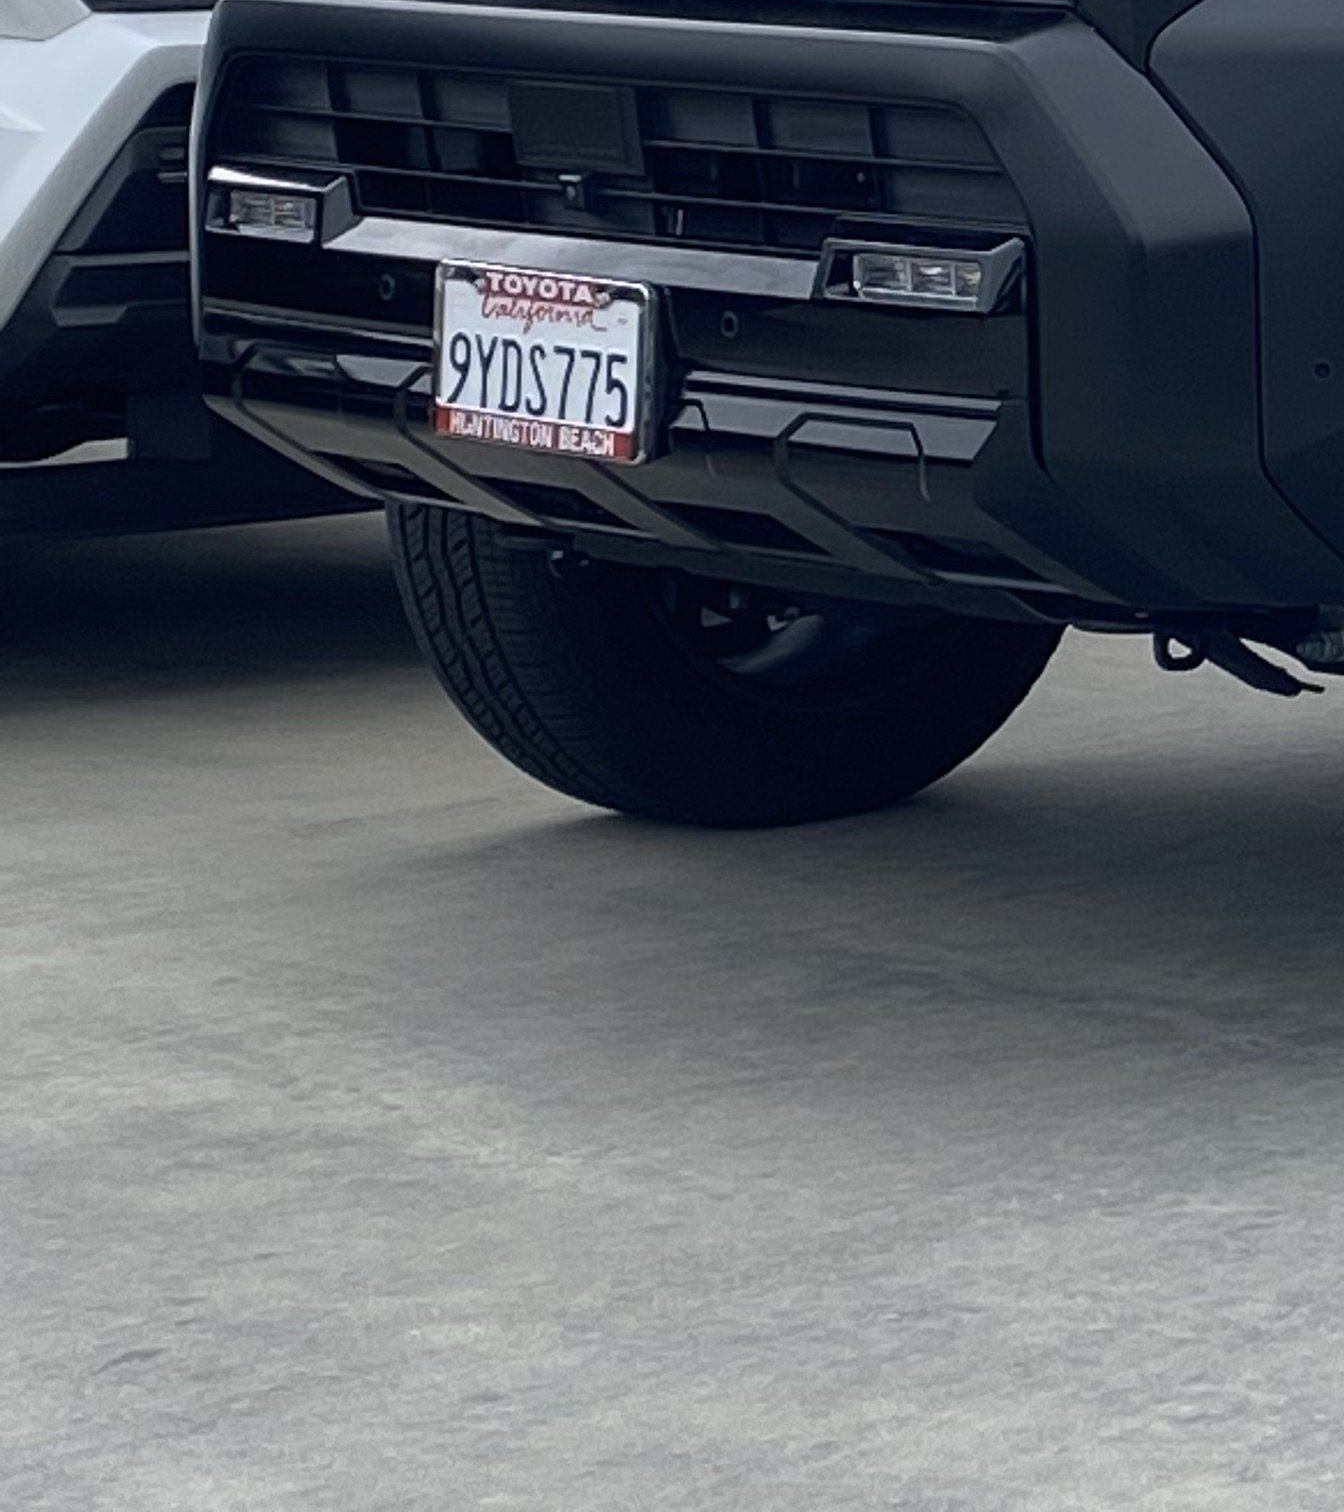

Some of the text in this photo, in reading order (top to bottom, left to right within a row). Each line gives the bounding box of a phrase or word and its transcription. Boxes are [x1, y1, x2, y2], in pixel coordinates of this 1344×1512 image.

[486, 271, 593, 303] TOYOTA
[447, 331, 629, 428] 9YDS775
[450, 411, 615, 457] HUNTINGTON BEACH
